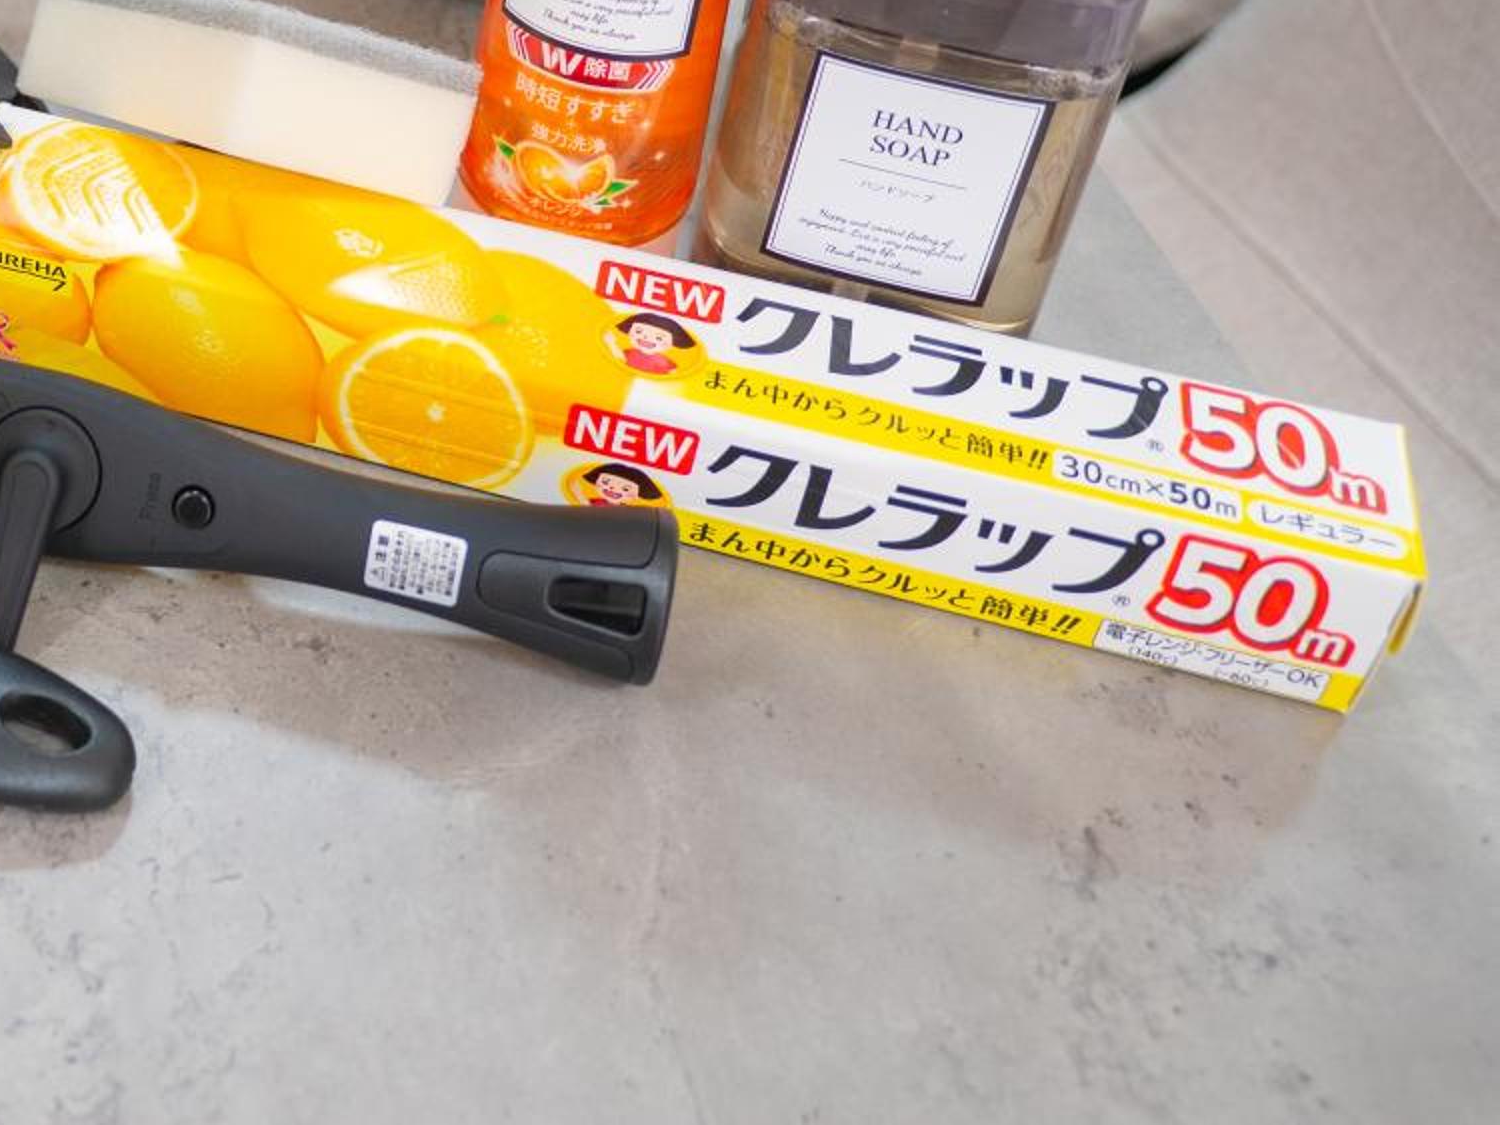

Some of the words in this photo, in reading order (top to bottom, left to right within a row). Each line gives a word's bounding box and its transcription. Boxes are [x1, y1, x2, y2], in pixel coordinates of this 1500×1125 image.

[516, 72, 633, 124] 時短すすぎ
[870, 135, 951, 166] SOAP
[874, 110, 963, 144] HAND
[603, 267, 721, 319] NEW
[736, 298, 1169, 439] クレラップ
[573, 410, 697, 465] NEW
[1179, 380, 1387, 514] 50m
[705, 445, 1165, 595] クレラップ
[1261, 505, 1396, 548] レギュラー
[1145, 533, 1356, 668] 50m
